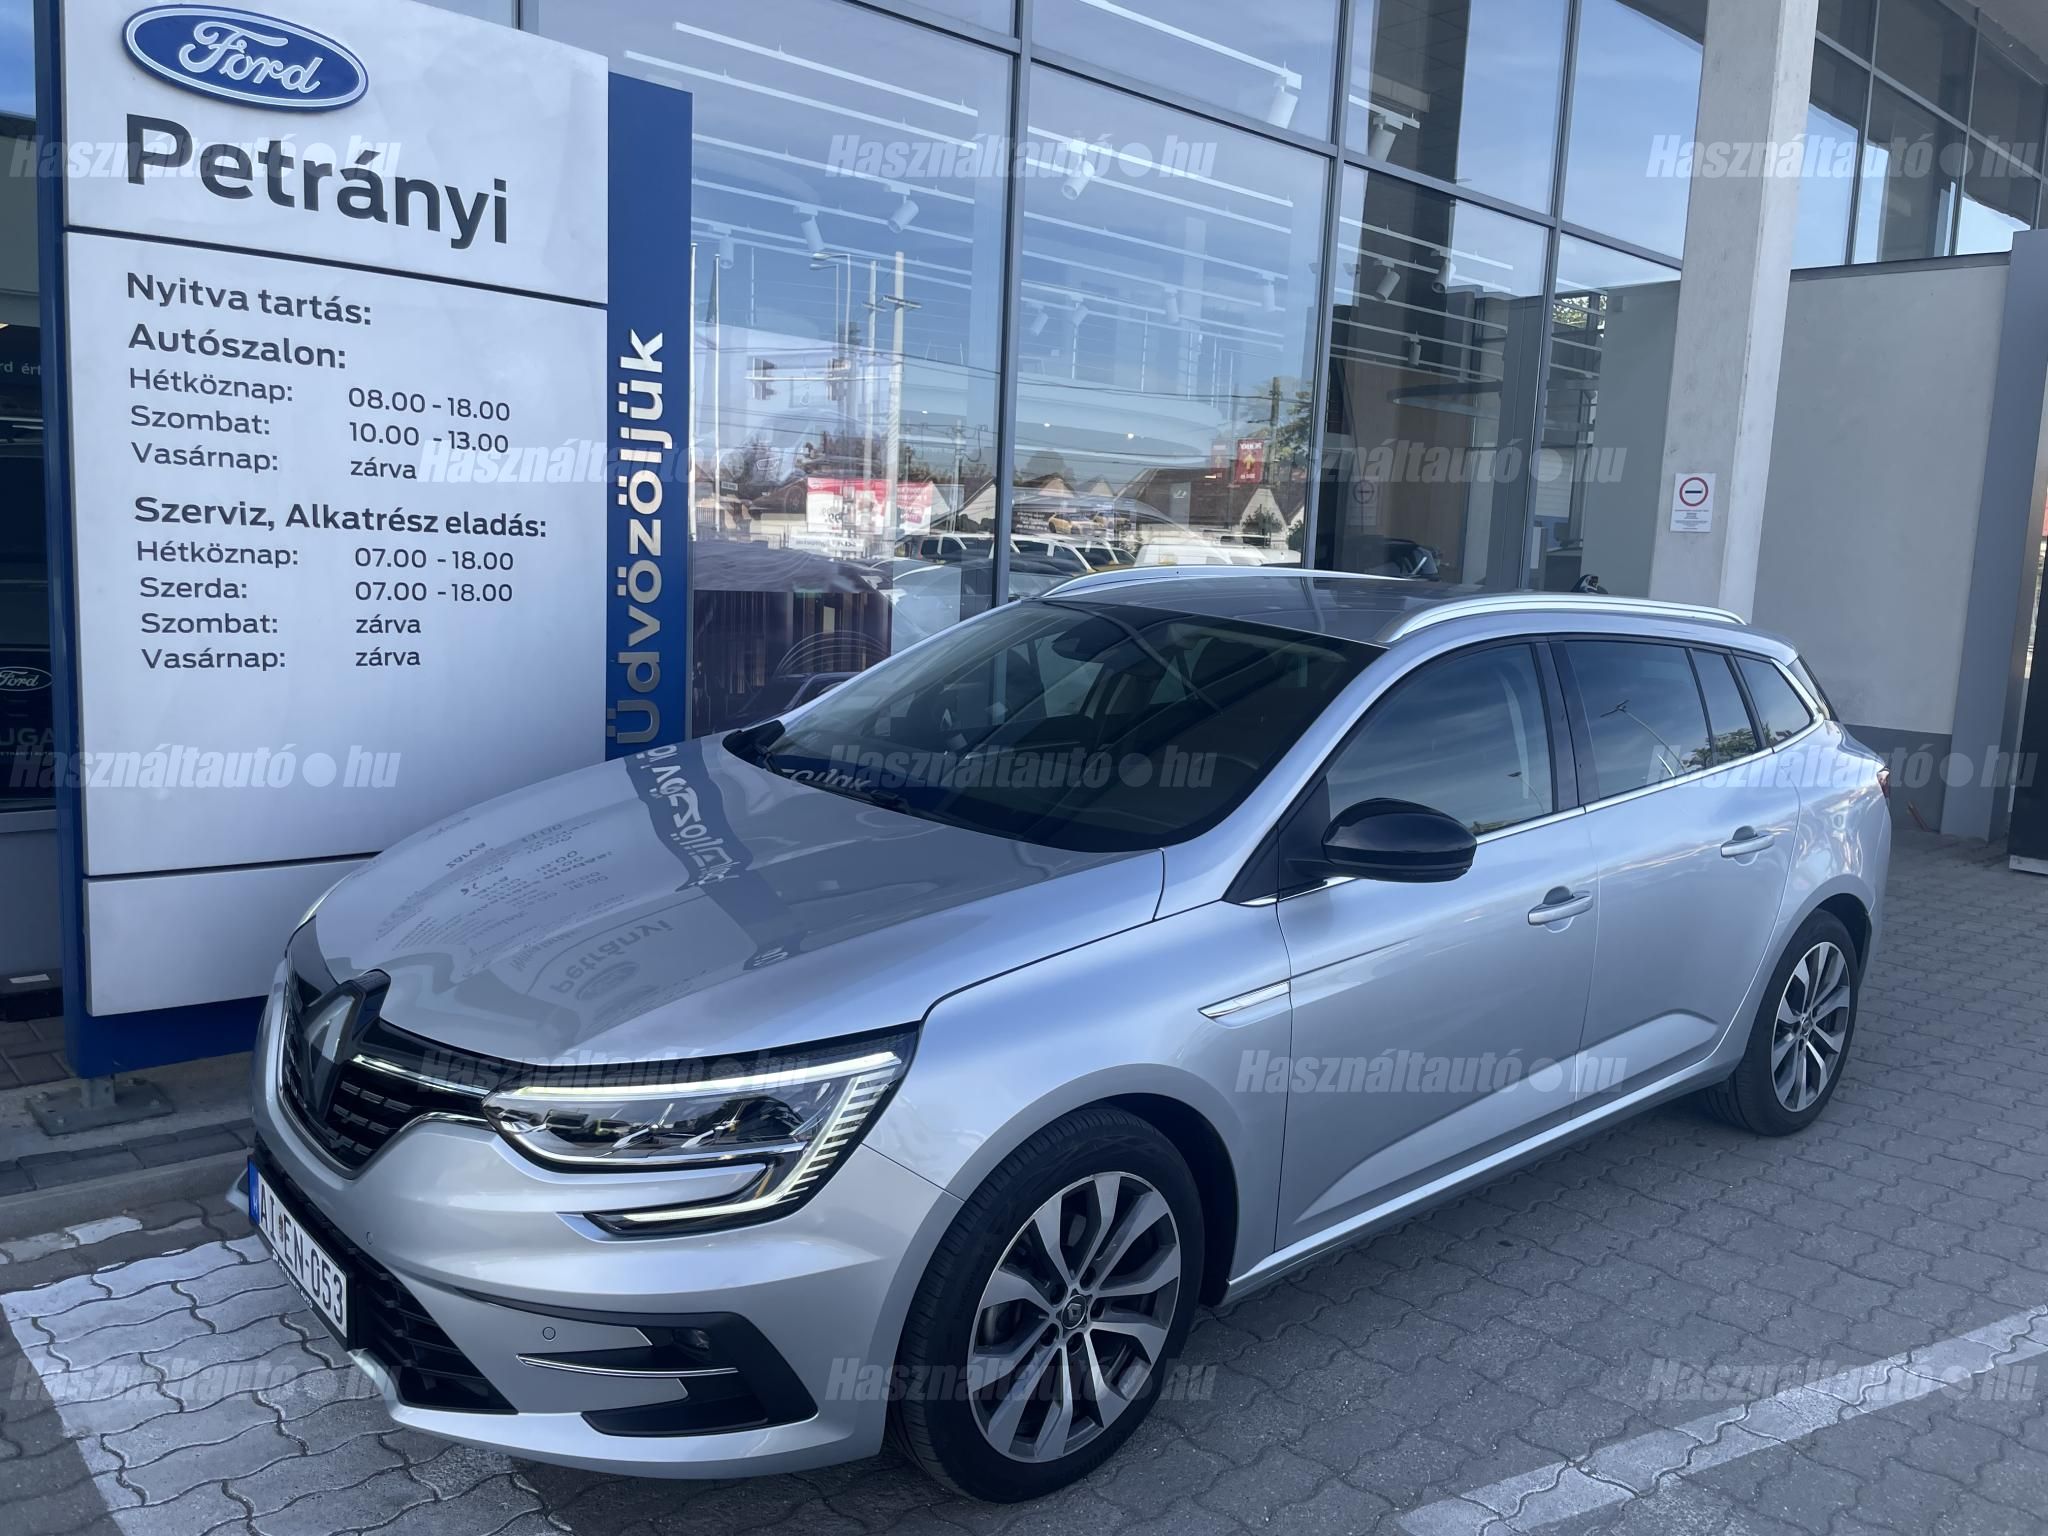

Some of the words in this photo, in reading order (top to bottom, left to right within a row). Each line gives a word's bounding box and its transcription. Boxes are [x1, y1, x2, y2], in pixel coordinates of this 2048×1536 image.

[178, 19, 322, 94] Ford
[126, 113, 508, 250] Petrányi
[127, 272, 249, 312] Nyitva
[258, 289, 372, 326] tartás:
[128, 323, 346, 369] Autószalon:
[129, 367, 293, 404] Hétköznap:
[348, 387, 426, 414] 08.00
[130, 404, 270, 435] Szombat:
[348, 421, 420, 446] 10.00
[131, 441, 278, 474] Vasárnap:
[350, 456, 417, 480] zárva
[134, 496, 275, 531] Szerviz,
[285, 503, 439, 533] Alkatrész
[445, 511, 547, 538] eladás:
[606, 329, 674, 744] Üdvözöljük
[137, 540, 299, 568] Hétköznap:
[354, 548, 427, 568] 07.00
[140, 576, 248, 599] Szerda:
[355, 581, 427, 601] 07.00
[141, 612, 279, 634] Szombat:
[355, 614, 422, 634] zárva
[141, 647, 287, 672] Vasárnap:
[355, 647, 421, 667] zárva
